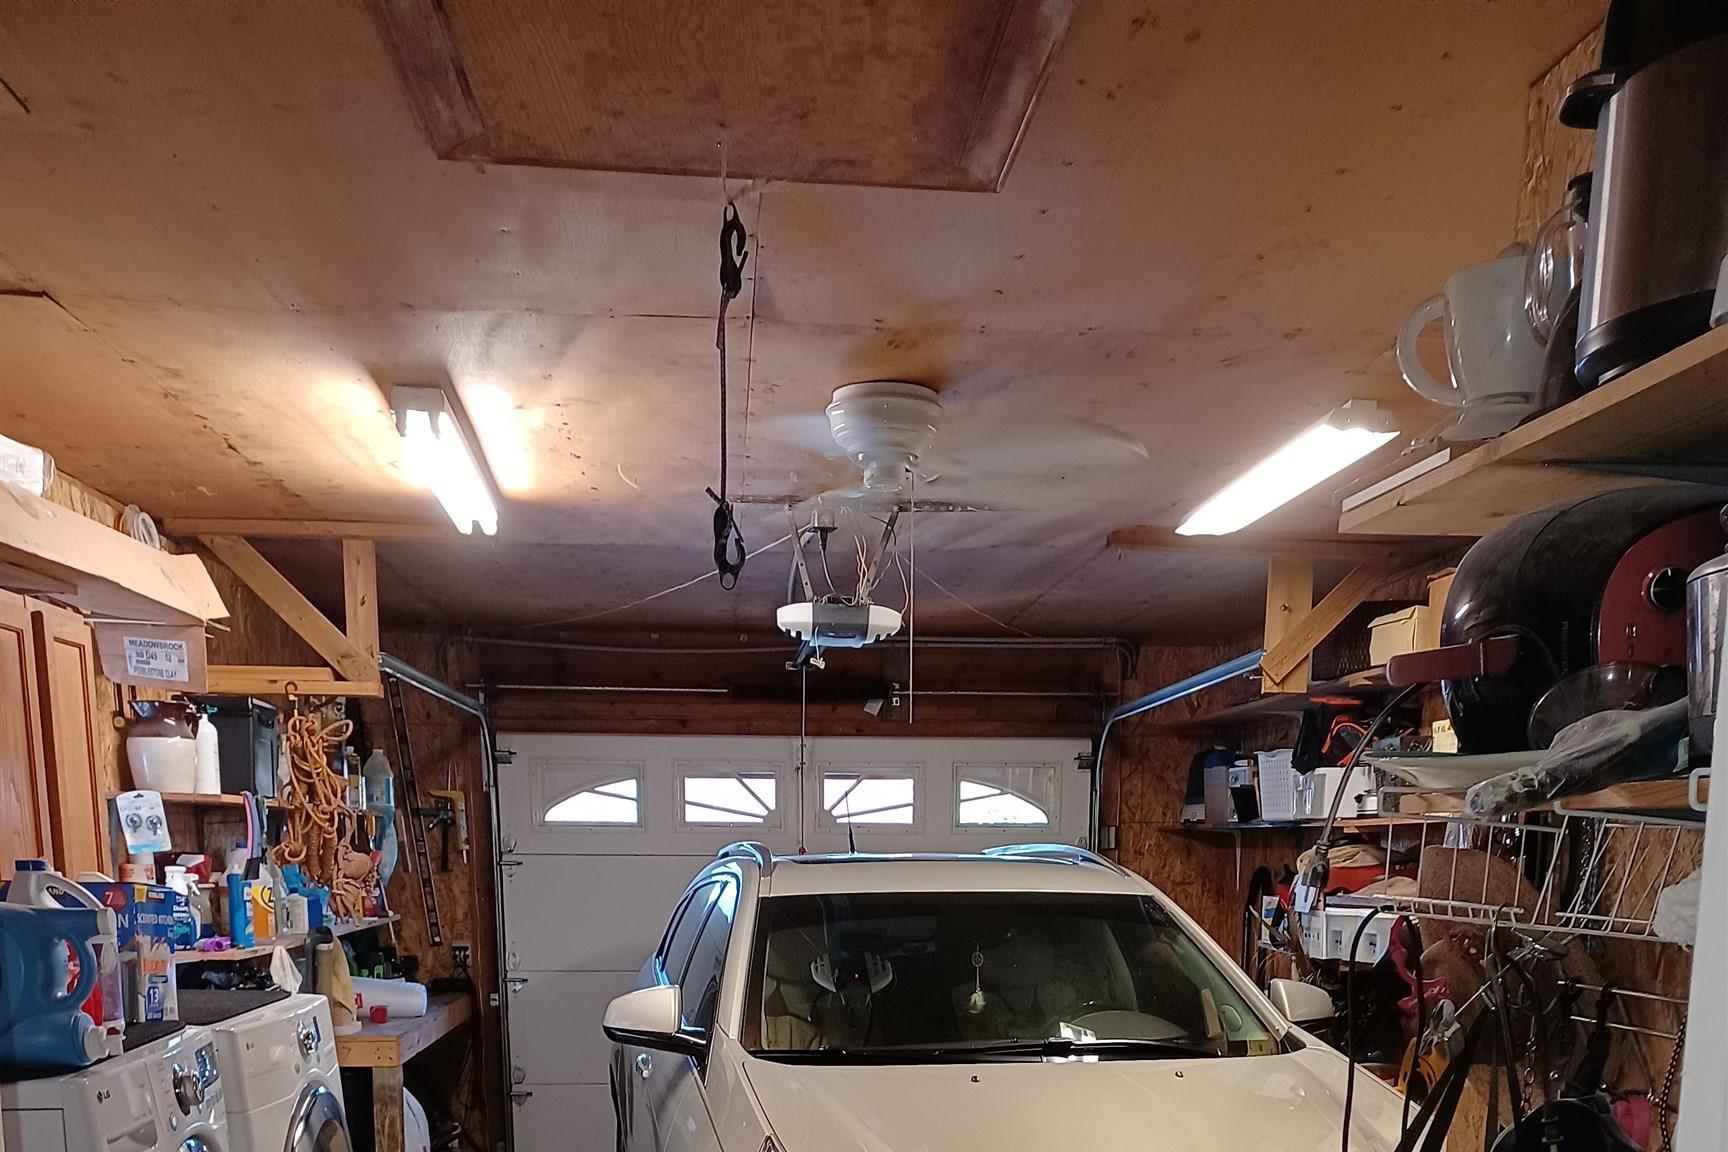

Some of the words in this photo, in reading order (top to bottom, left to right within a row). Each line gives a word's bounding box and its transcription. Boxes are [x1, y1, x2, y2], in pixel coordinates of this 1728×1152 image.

[128, 639, 184, 650] MEADOWBROOK
[105, 891, 114, 905] 7
[149, 988, 159, 1004] 13
